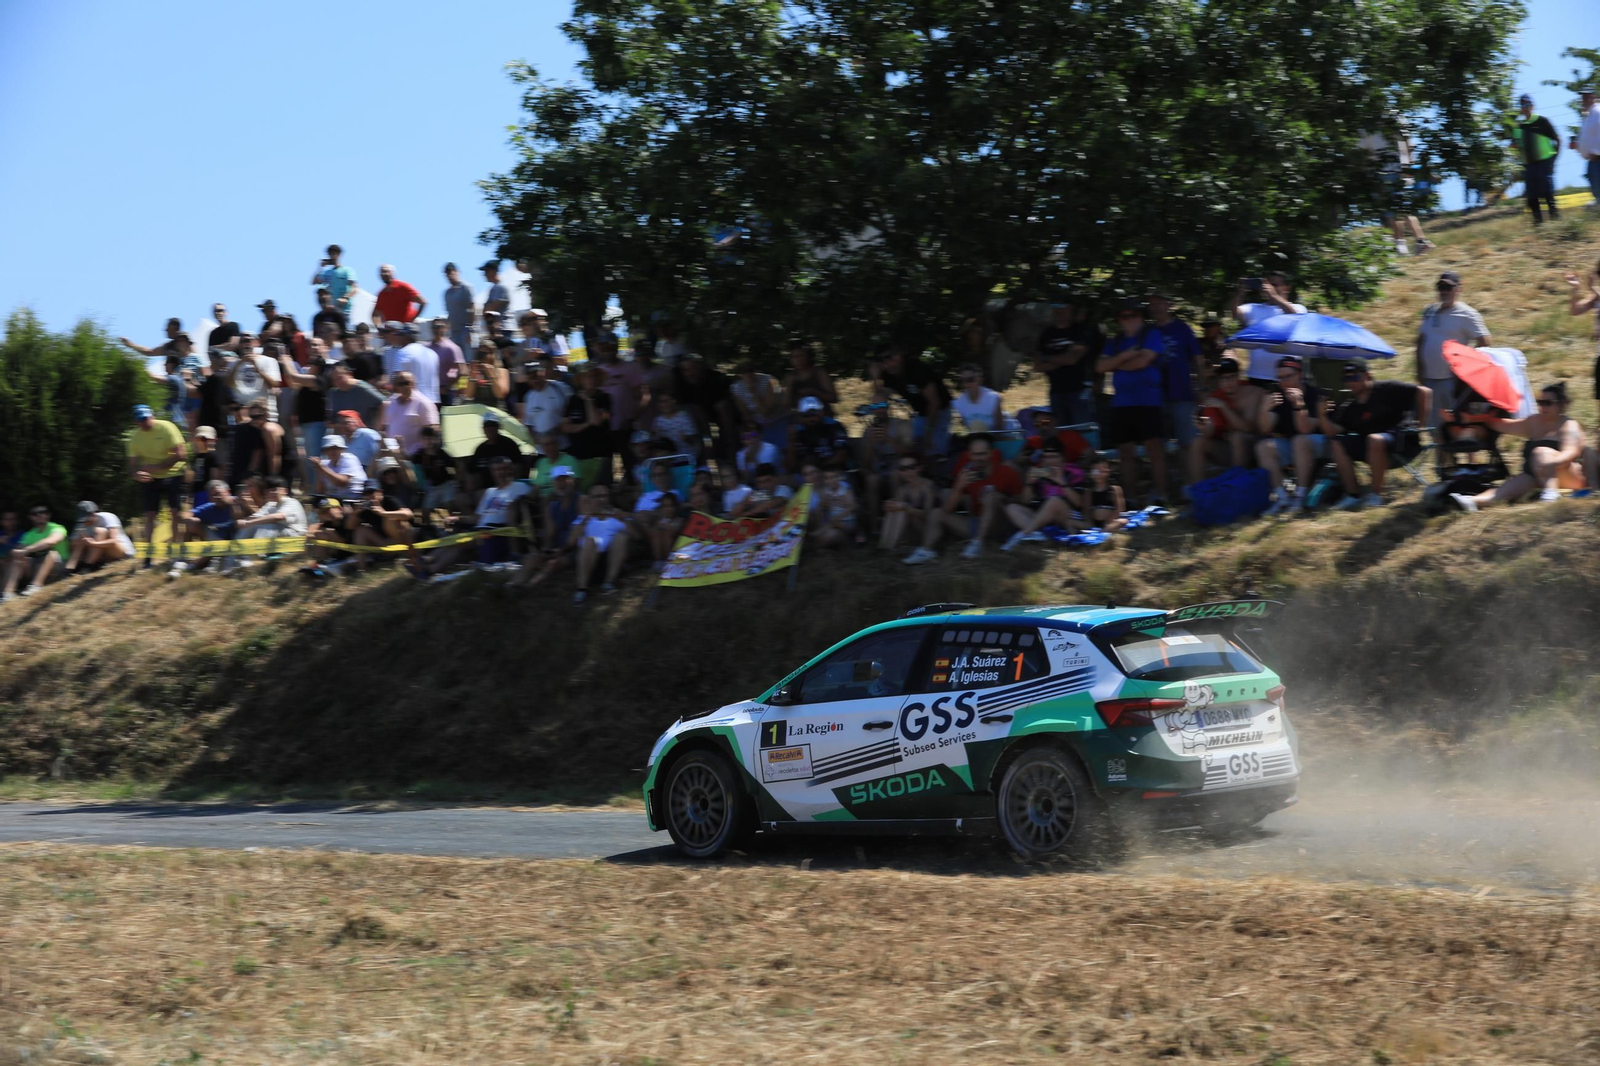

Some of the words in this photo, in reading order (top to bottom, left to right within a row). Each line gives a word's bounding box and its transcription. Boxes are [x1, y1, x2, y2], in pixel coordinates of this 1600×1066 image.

[951, 657, 970, 669] J.A.
[972, 655, 1007, 668] Suárez
[1013, 652, 1024, 681] 1
[949, 671, 959, 683] A.
[960, 670, 999, 684] Iglesias
[900, 691, 977, 742] GSS
[769, 723, 777, 745] 1
[788, 725, 803, 736] La
[1208, 730, 1264, 747] MICHELIN
[903, 742, 936, 758] Subsea
[938, 731, 977, 748] Services
[1229, 752, 1260, 776] GSS
